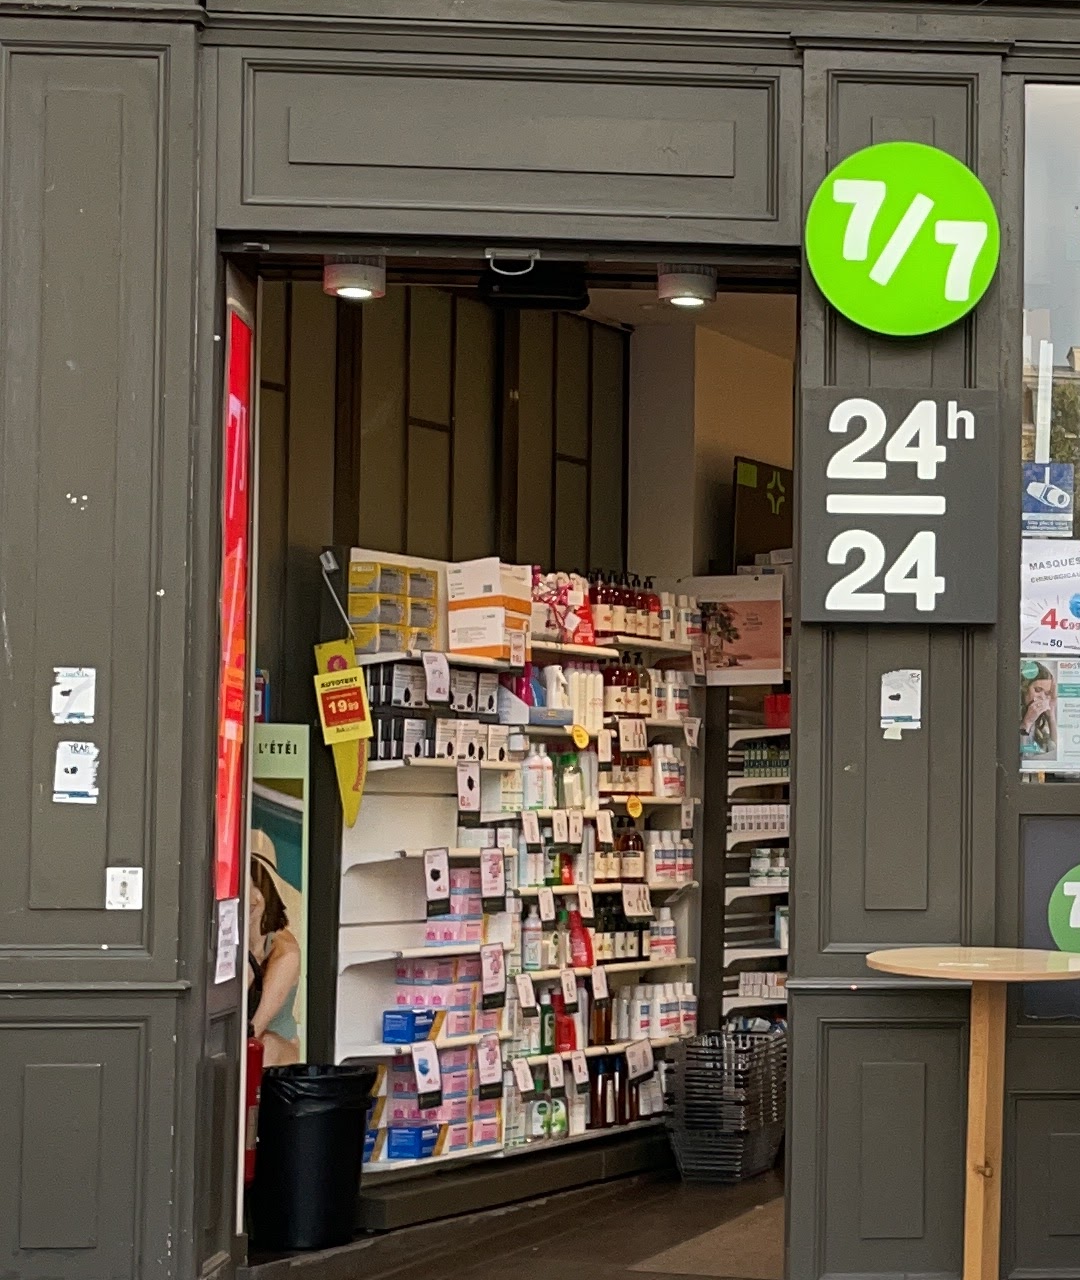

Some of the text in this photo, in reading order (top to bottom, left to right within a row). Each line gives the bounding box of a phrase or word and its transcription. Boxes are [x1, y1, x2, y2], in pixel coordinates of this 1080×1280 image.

[832, 179, 988, 302] 7/7
[825, 528, 946, 612] 24
[1050, 639, 1063, 649] 50
